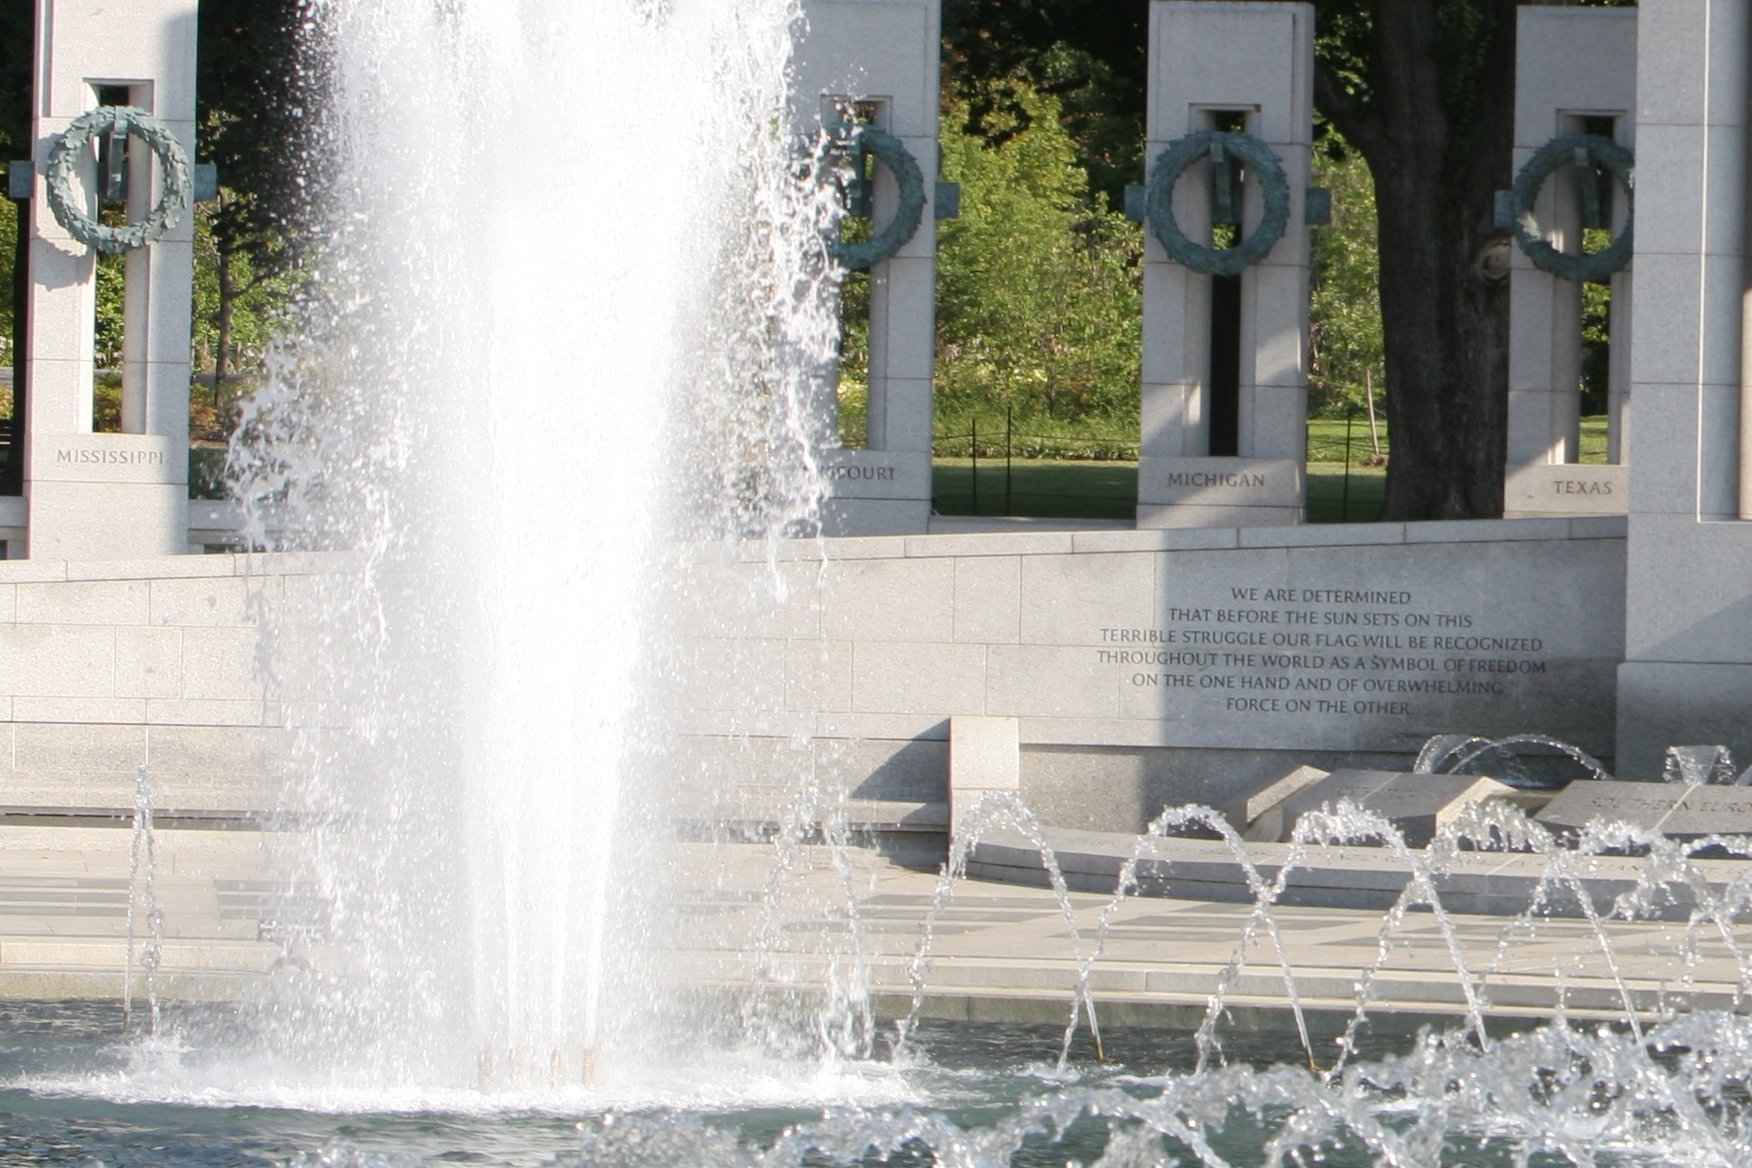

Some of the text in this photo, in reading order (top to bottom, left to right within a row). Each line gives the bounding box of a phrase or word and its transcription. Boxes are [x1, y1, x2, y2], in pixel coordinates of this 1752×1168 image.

[57, 449, 164, 465] MISSISSIPPI
[1168, 472, 1265, 487] MICHIGAN
[1553, 480, 1613, 495] TEXAS
[1232, 588, 1412, 605] WE ARE DETERMINED
[1168, 608, 1472, 628] THAT BEFORE THE SUN SETS ON THIS
[1100, 628, 1543, 652] TERRIBLE STRUGGLE OUR FLAG WILL BE RECOGNIZED
[1096, 650, 1546, 674] THROUGHOUT THE WORLD AS A SYMBOL OF FREEDOM
[1132, 673, 1504, 696] ON THE ONE HAND AND OF OVERWHELMING
[1226, 697, 1280, 712] FORCE
[1284, 699, 1312, 713] ON
[1316, 700, 1348, 714] THE
[1588, 797, 1694, 811] SOUTHERN
